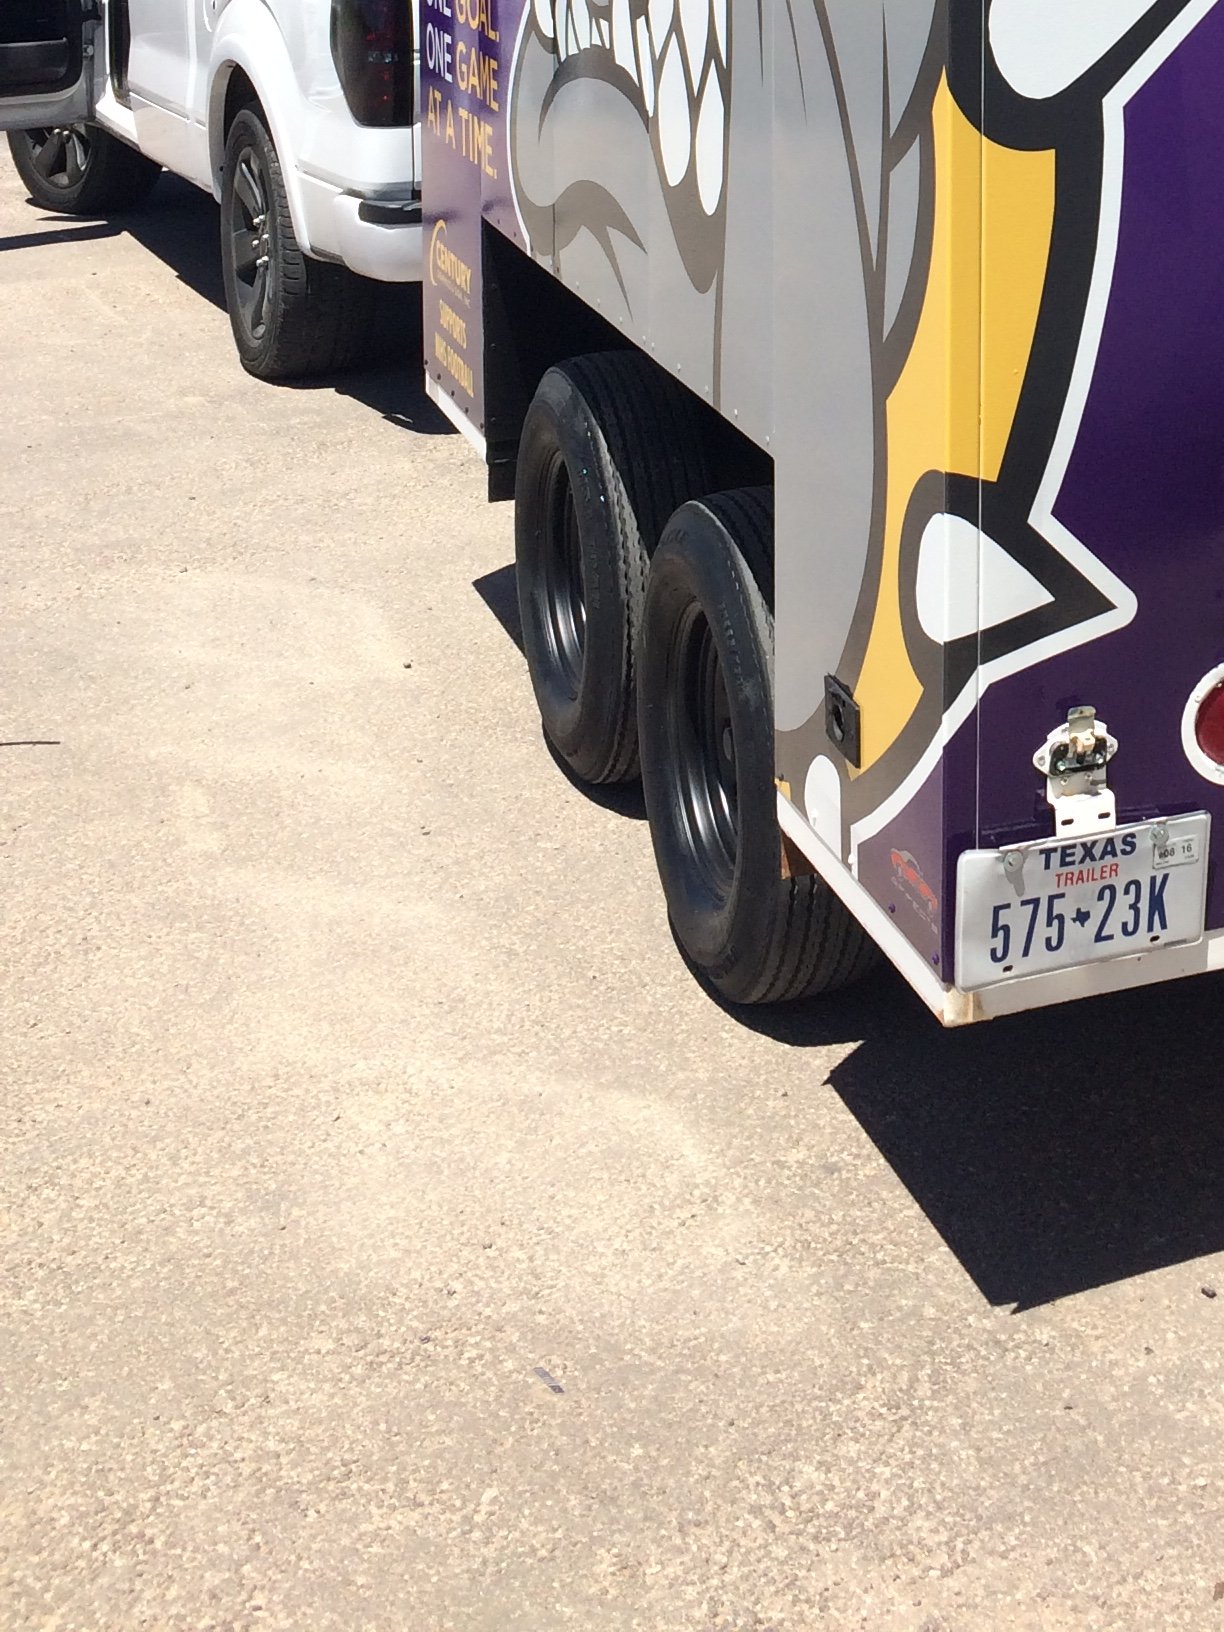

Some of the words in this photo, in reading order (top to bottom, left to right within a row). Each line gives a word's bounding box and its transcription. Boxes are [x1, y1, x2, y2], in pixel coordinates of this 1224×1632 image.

[426, 22, 453, 83] ONE
[456, 39, 499, 112] GAME
[427, 85, 442, 137] AT
[445, 99, 456, 150] A
[459, 108, 498, 180] TIME.
[436, 239, 472, 295] CENTURY
[1039, 833, 1137, 870] TEXAS
[1055, 863, 1120, 888] TRAILER
[990, 892, 1066, 963] 575
[1094, 873, 1170, 944] 23K
